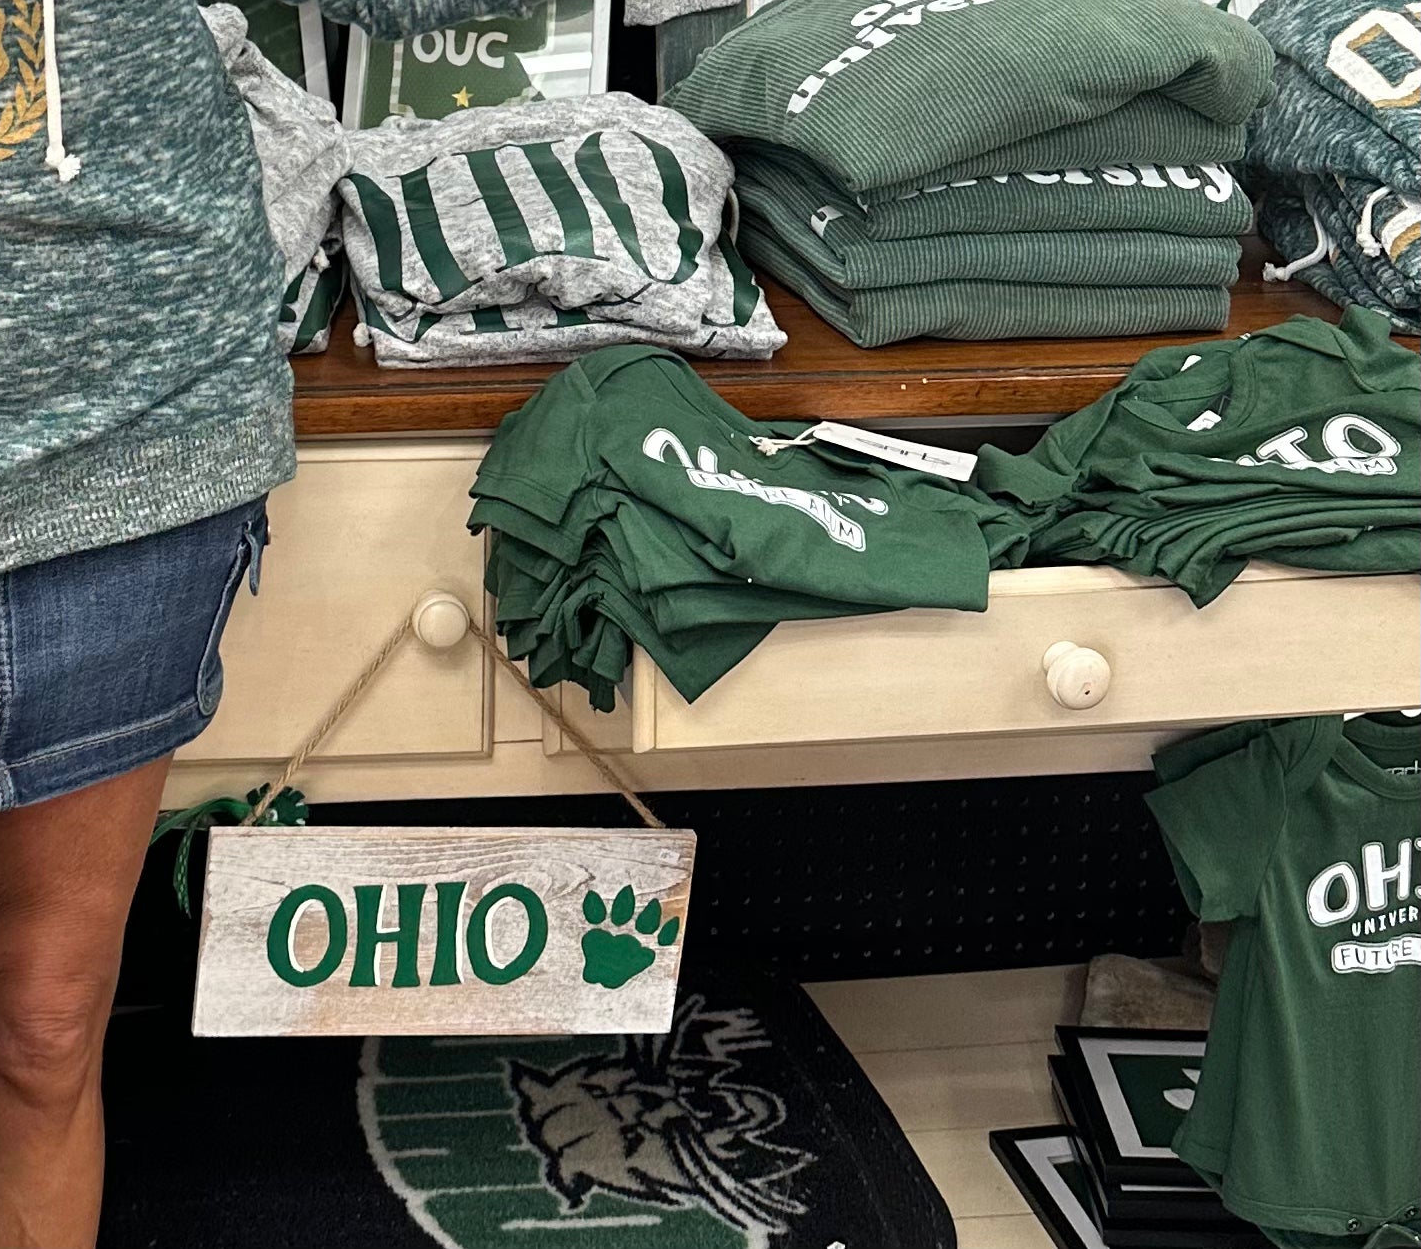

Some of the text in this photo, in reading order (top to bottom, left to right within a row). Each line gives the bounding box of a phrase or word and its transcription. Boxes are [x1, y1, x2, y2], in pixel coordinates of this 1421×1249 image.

[412, 29, 509, 69] OUC
[1307, 838, 1421, 928] OH
[267, 881, 548, 989] OHIO
[1352, 905, 1419, 937] UNIVER
